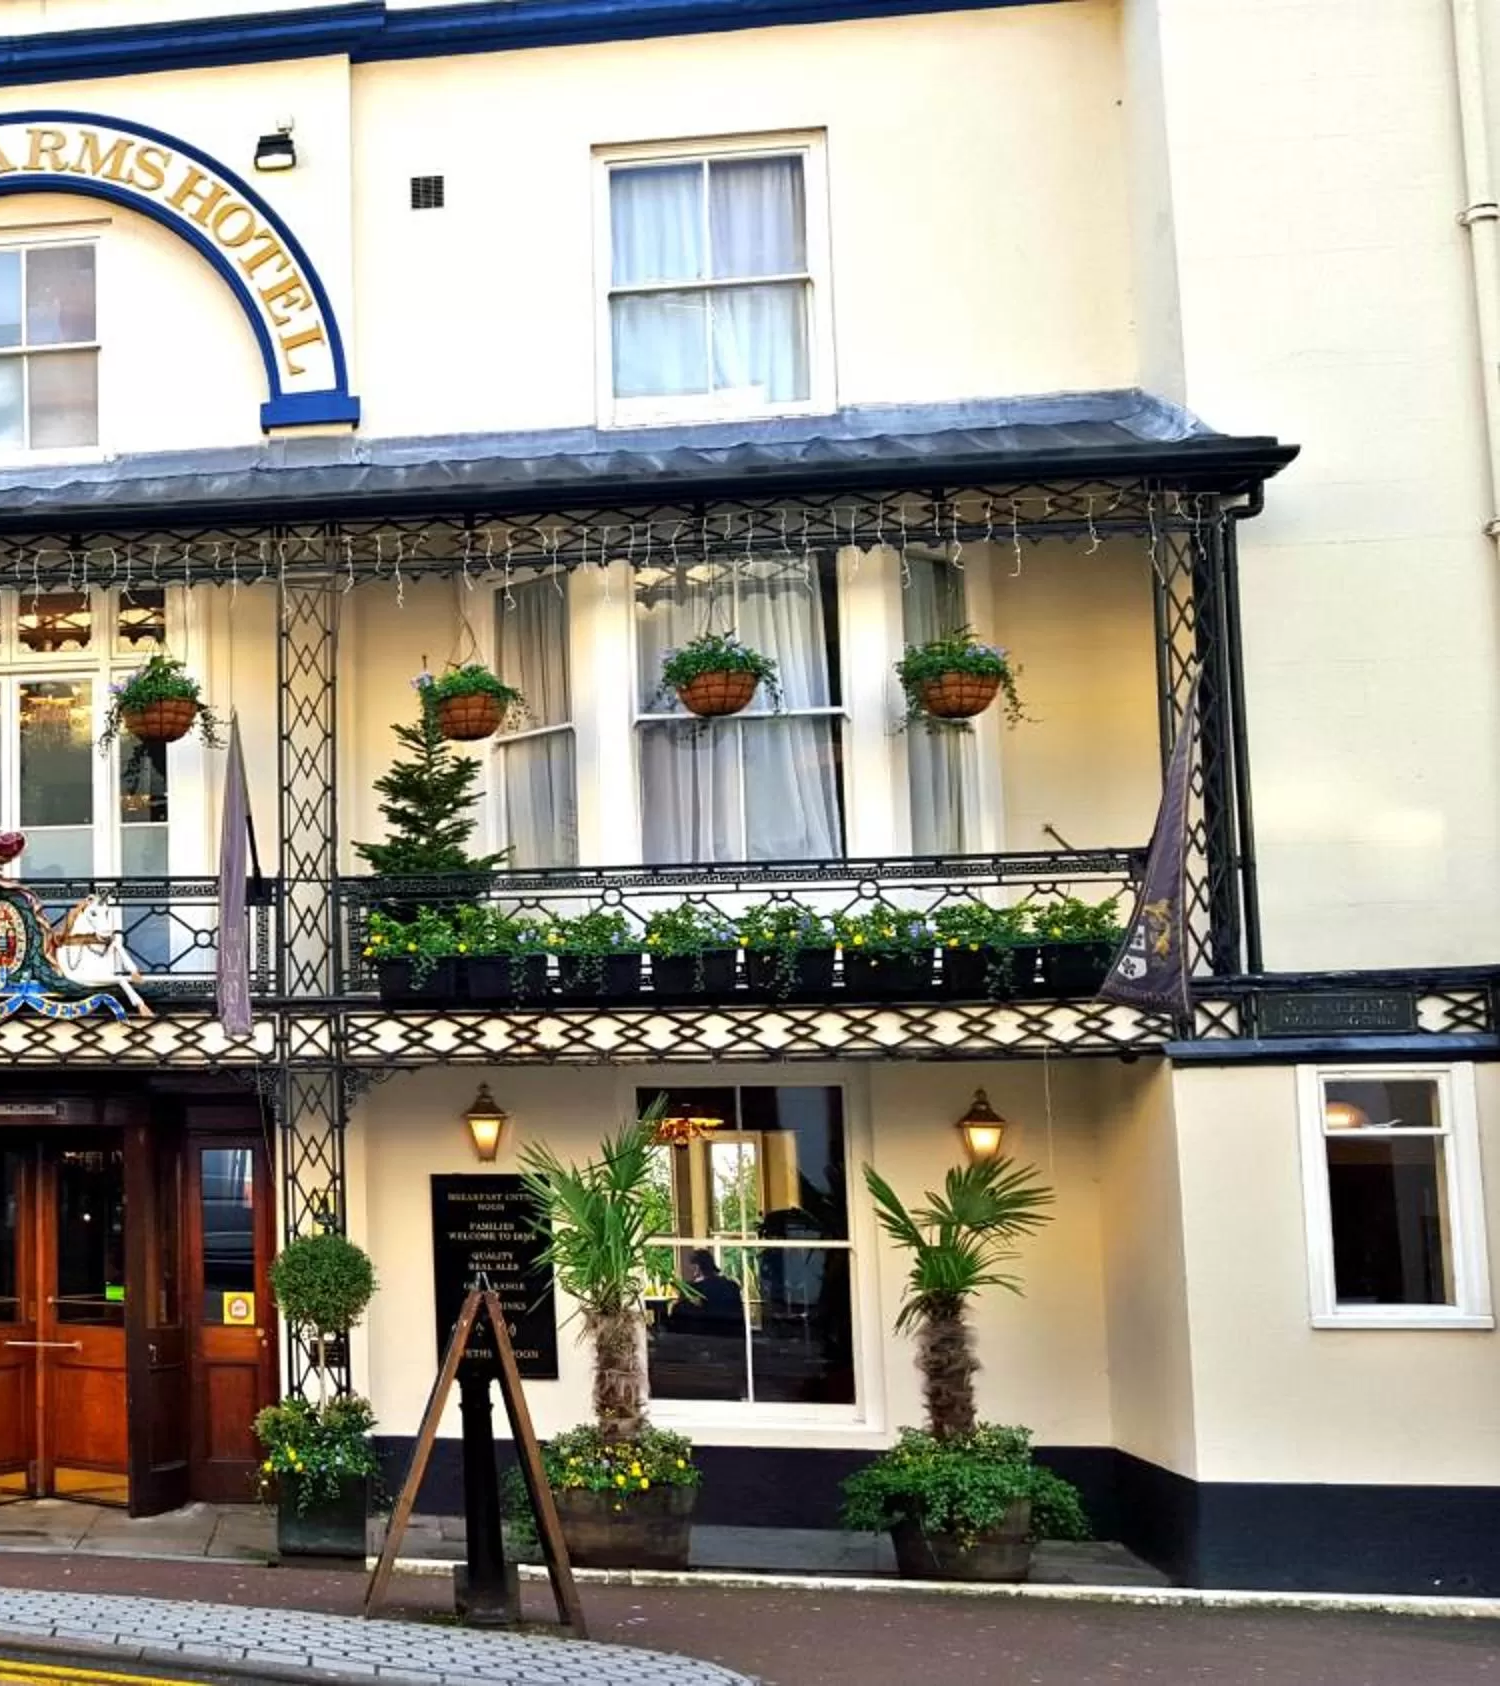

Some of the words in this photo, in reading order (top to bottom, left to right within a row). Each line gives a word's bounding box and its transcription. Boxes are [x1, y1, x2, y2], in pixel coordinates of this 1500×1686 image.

[165, 165, 326, 377] HOTEL
[469, 1222, 515, 1231] FAMILIES
[448, 1231, 496, 1241] WELCOME
[498, 1231, 512, 1241] TO
[470, 1251, 514, 1261] QUALITY
[467, 1263, 493, 1271] REAL
